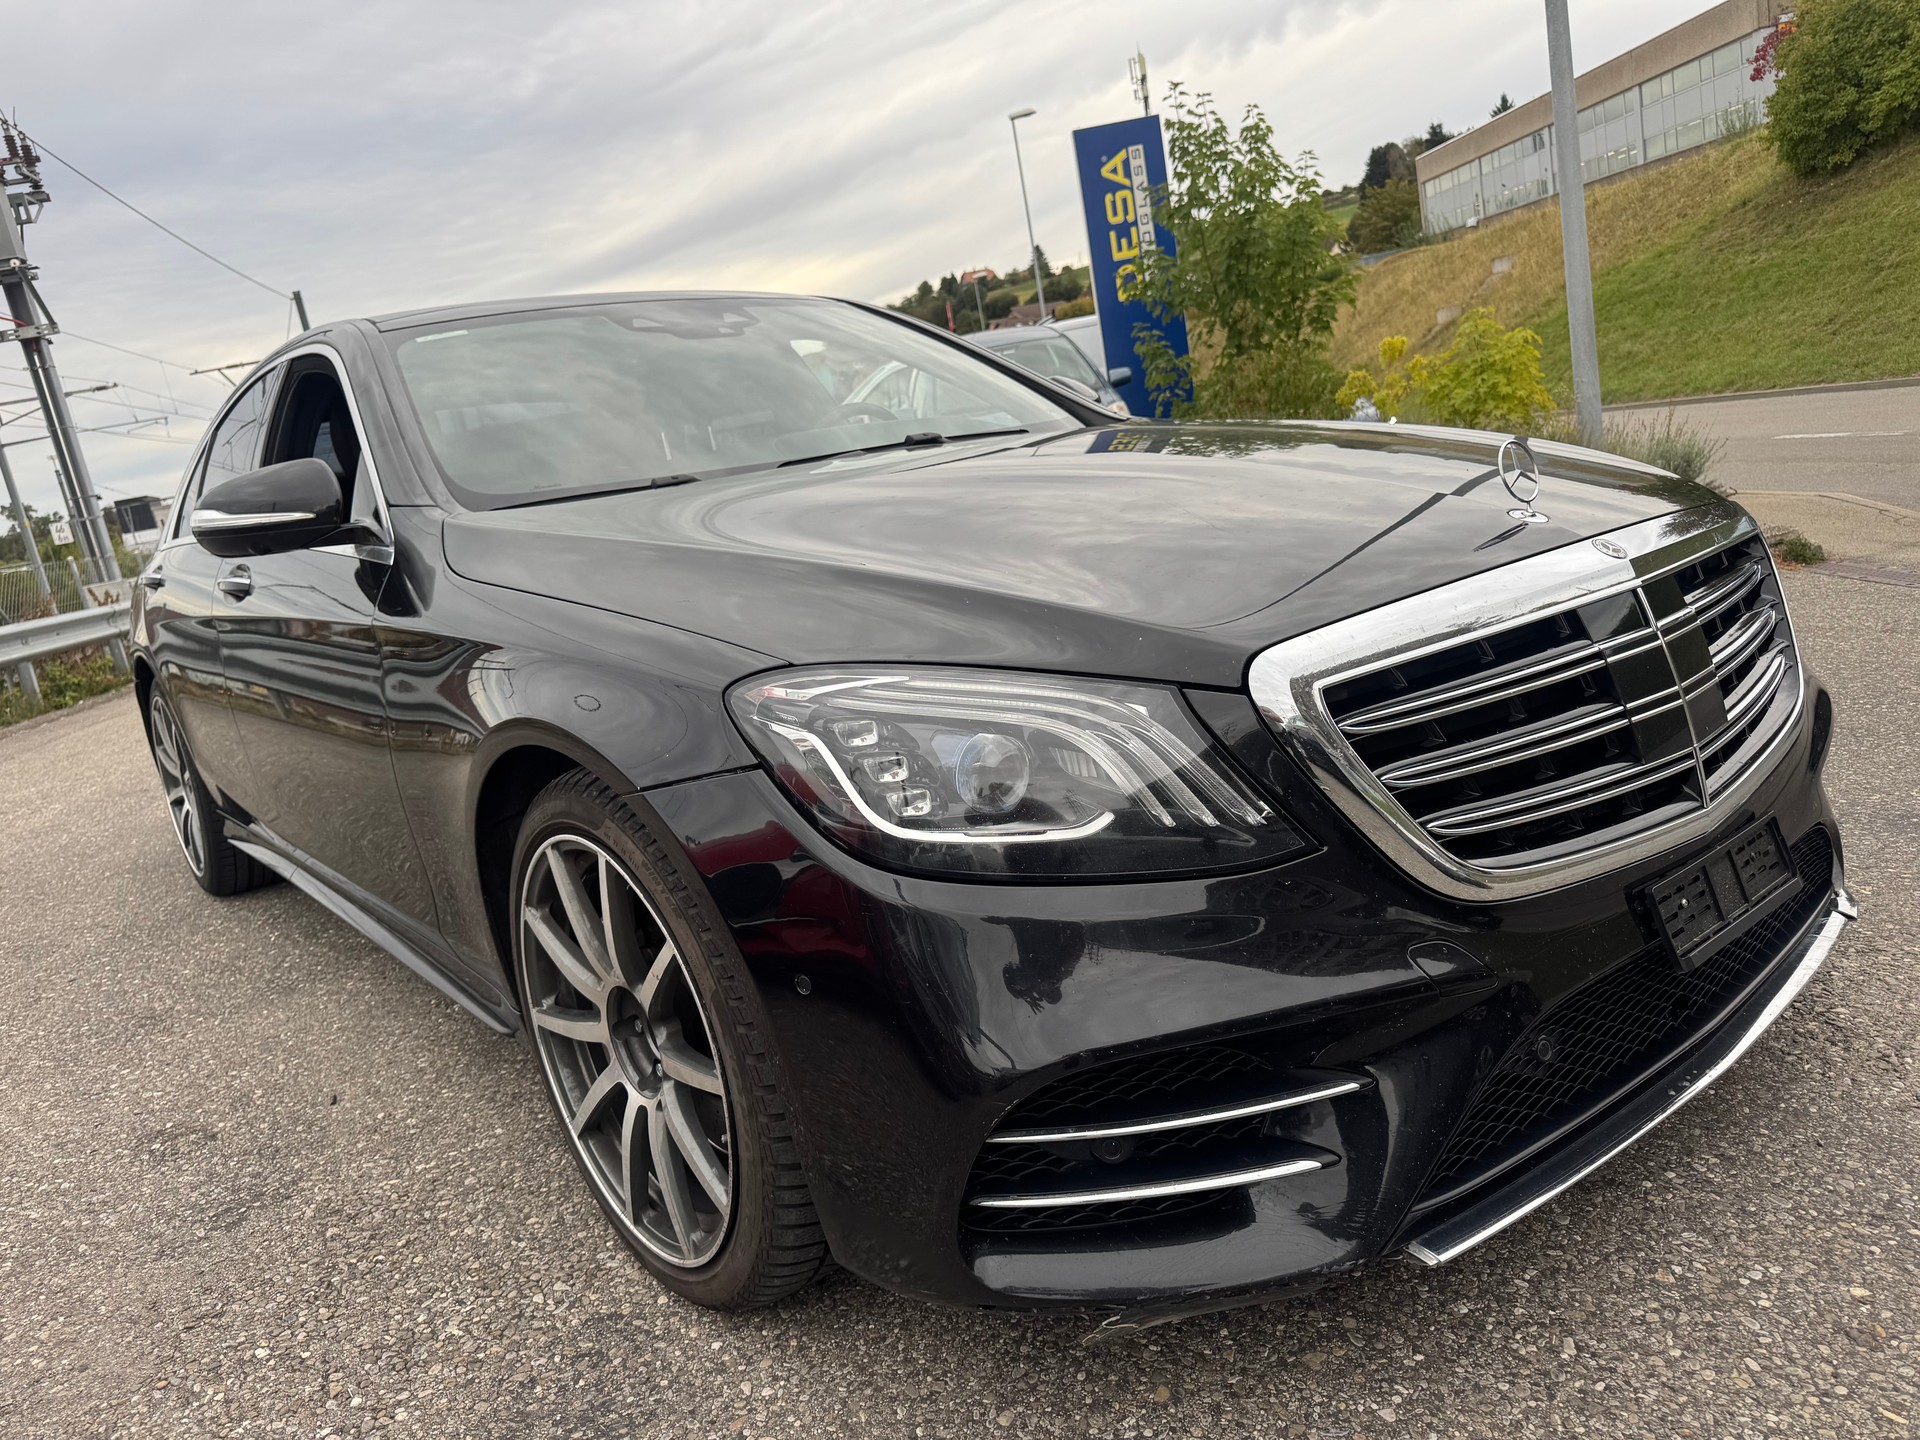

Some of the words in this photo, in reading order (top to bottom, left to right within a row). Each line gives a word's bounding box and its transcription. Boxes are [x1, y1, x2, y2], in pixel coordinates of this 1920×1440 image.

[1101, 147, 1143, 302] DESA
[1131, 148, 1155, 280] OGLASS
[641, 858, 682, 919] WINTER
